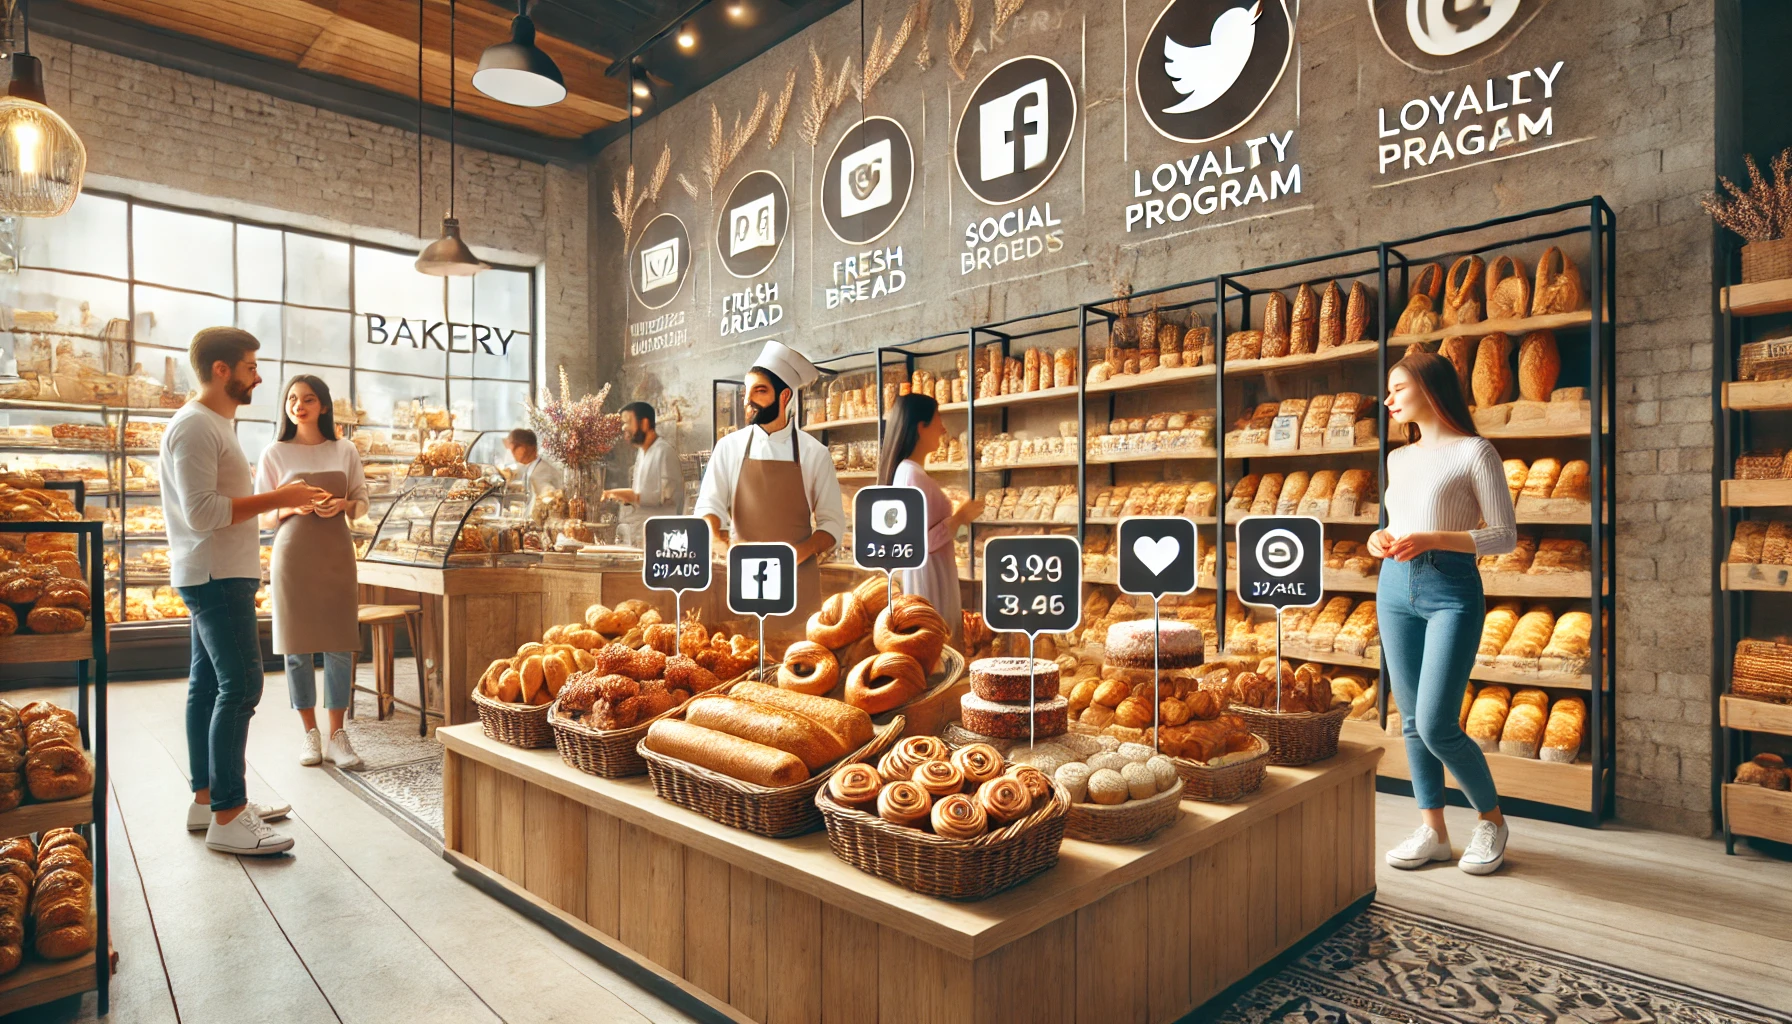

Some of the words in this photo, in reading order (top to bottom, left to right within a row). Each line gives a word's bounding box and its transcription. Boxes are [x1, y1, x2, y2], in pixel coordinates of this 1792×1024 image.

[1133, 130, 1294, 198] LOYALTY
[1125, 164, 1302, 233] PROGRAM
[965, 201, 1062, 249] SOCIAL
[833, 245, 903, 286] FRESH
[825, 270, 907, 310] BREAD
[364, 312, 515, 356] BAKERY
